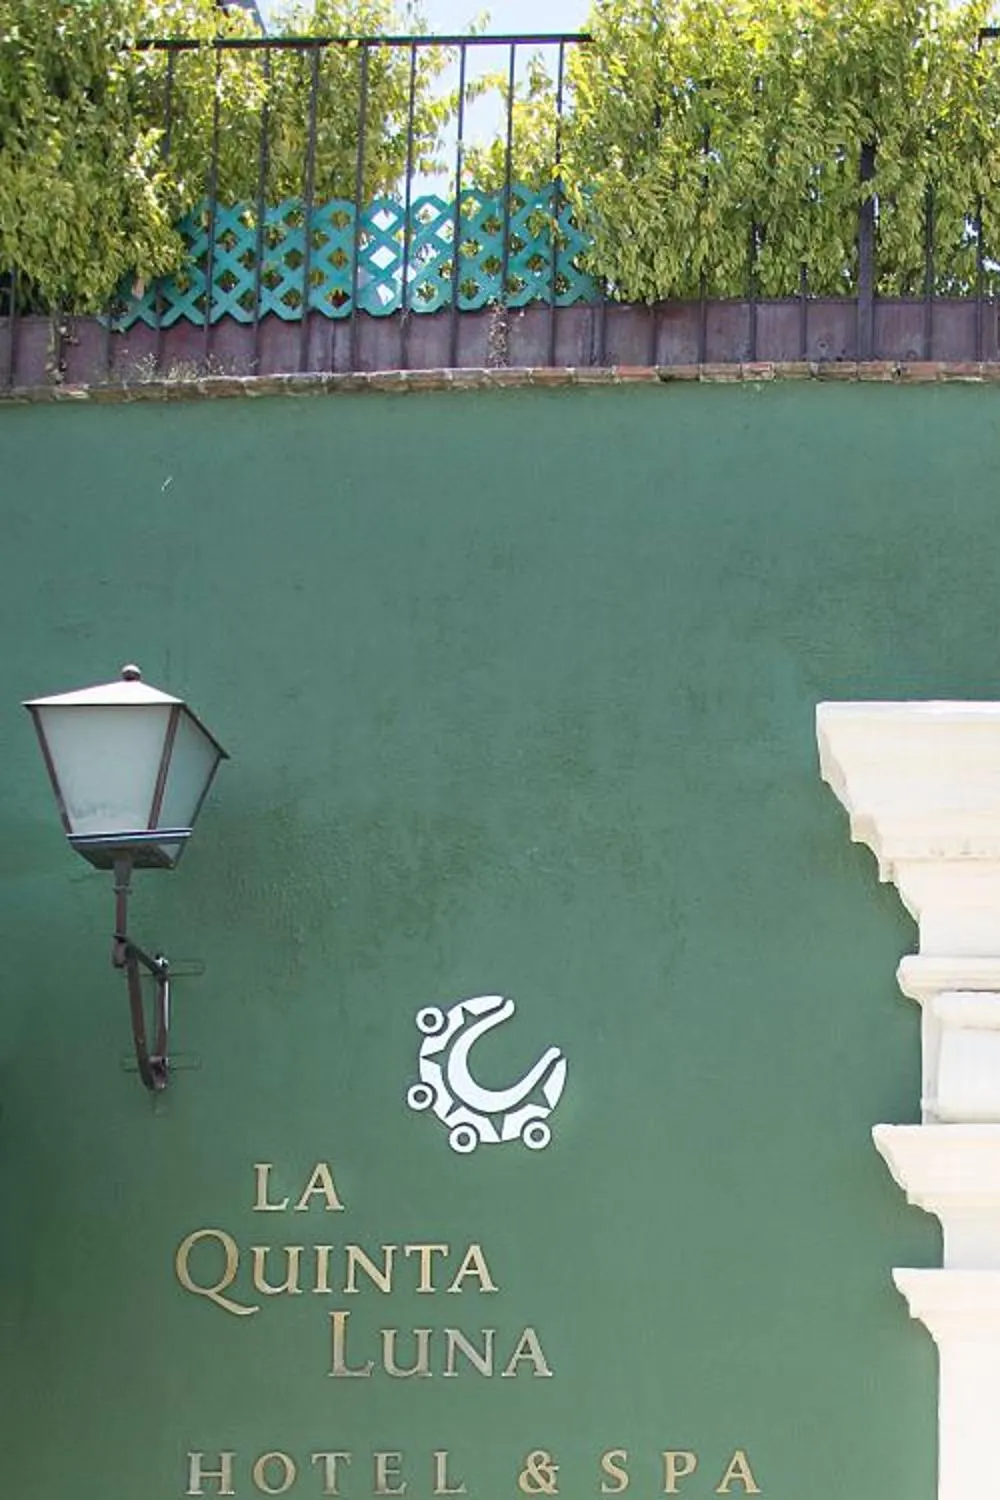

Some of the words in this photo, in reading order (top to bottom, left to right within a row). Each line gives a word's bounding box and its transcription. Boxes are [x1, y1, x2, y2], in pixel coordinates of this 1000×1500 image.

[252, 1163, 345, 1212] LA
[175, 1228, 499, 1315] QUINTA
[327, 1310, 554, 1378] LUNA
[186, 1450, 467, 1496] HOTEL
[517, 1449, 560, 1496] &
[600, 1449, 762, 1495] SPA
